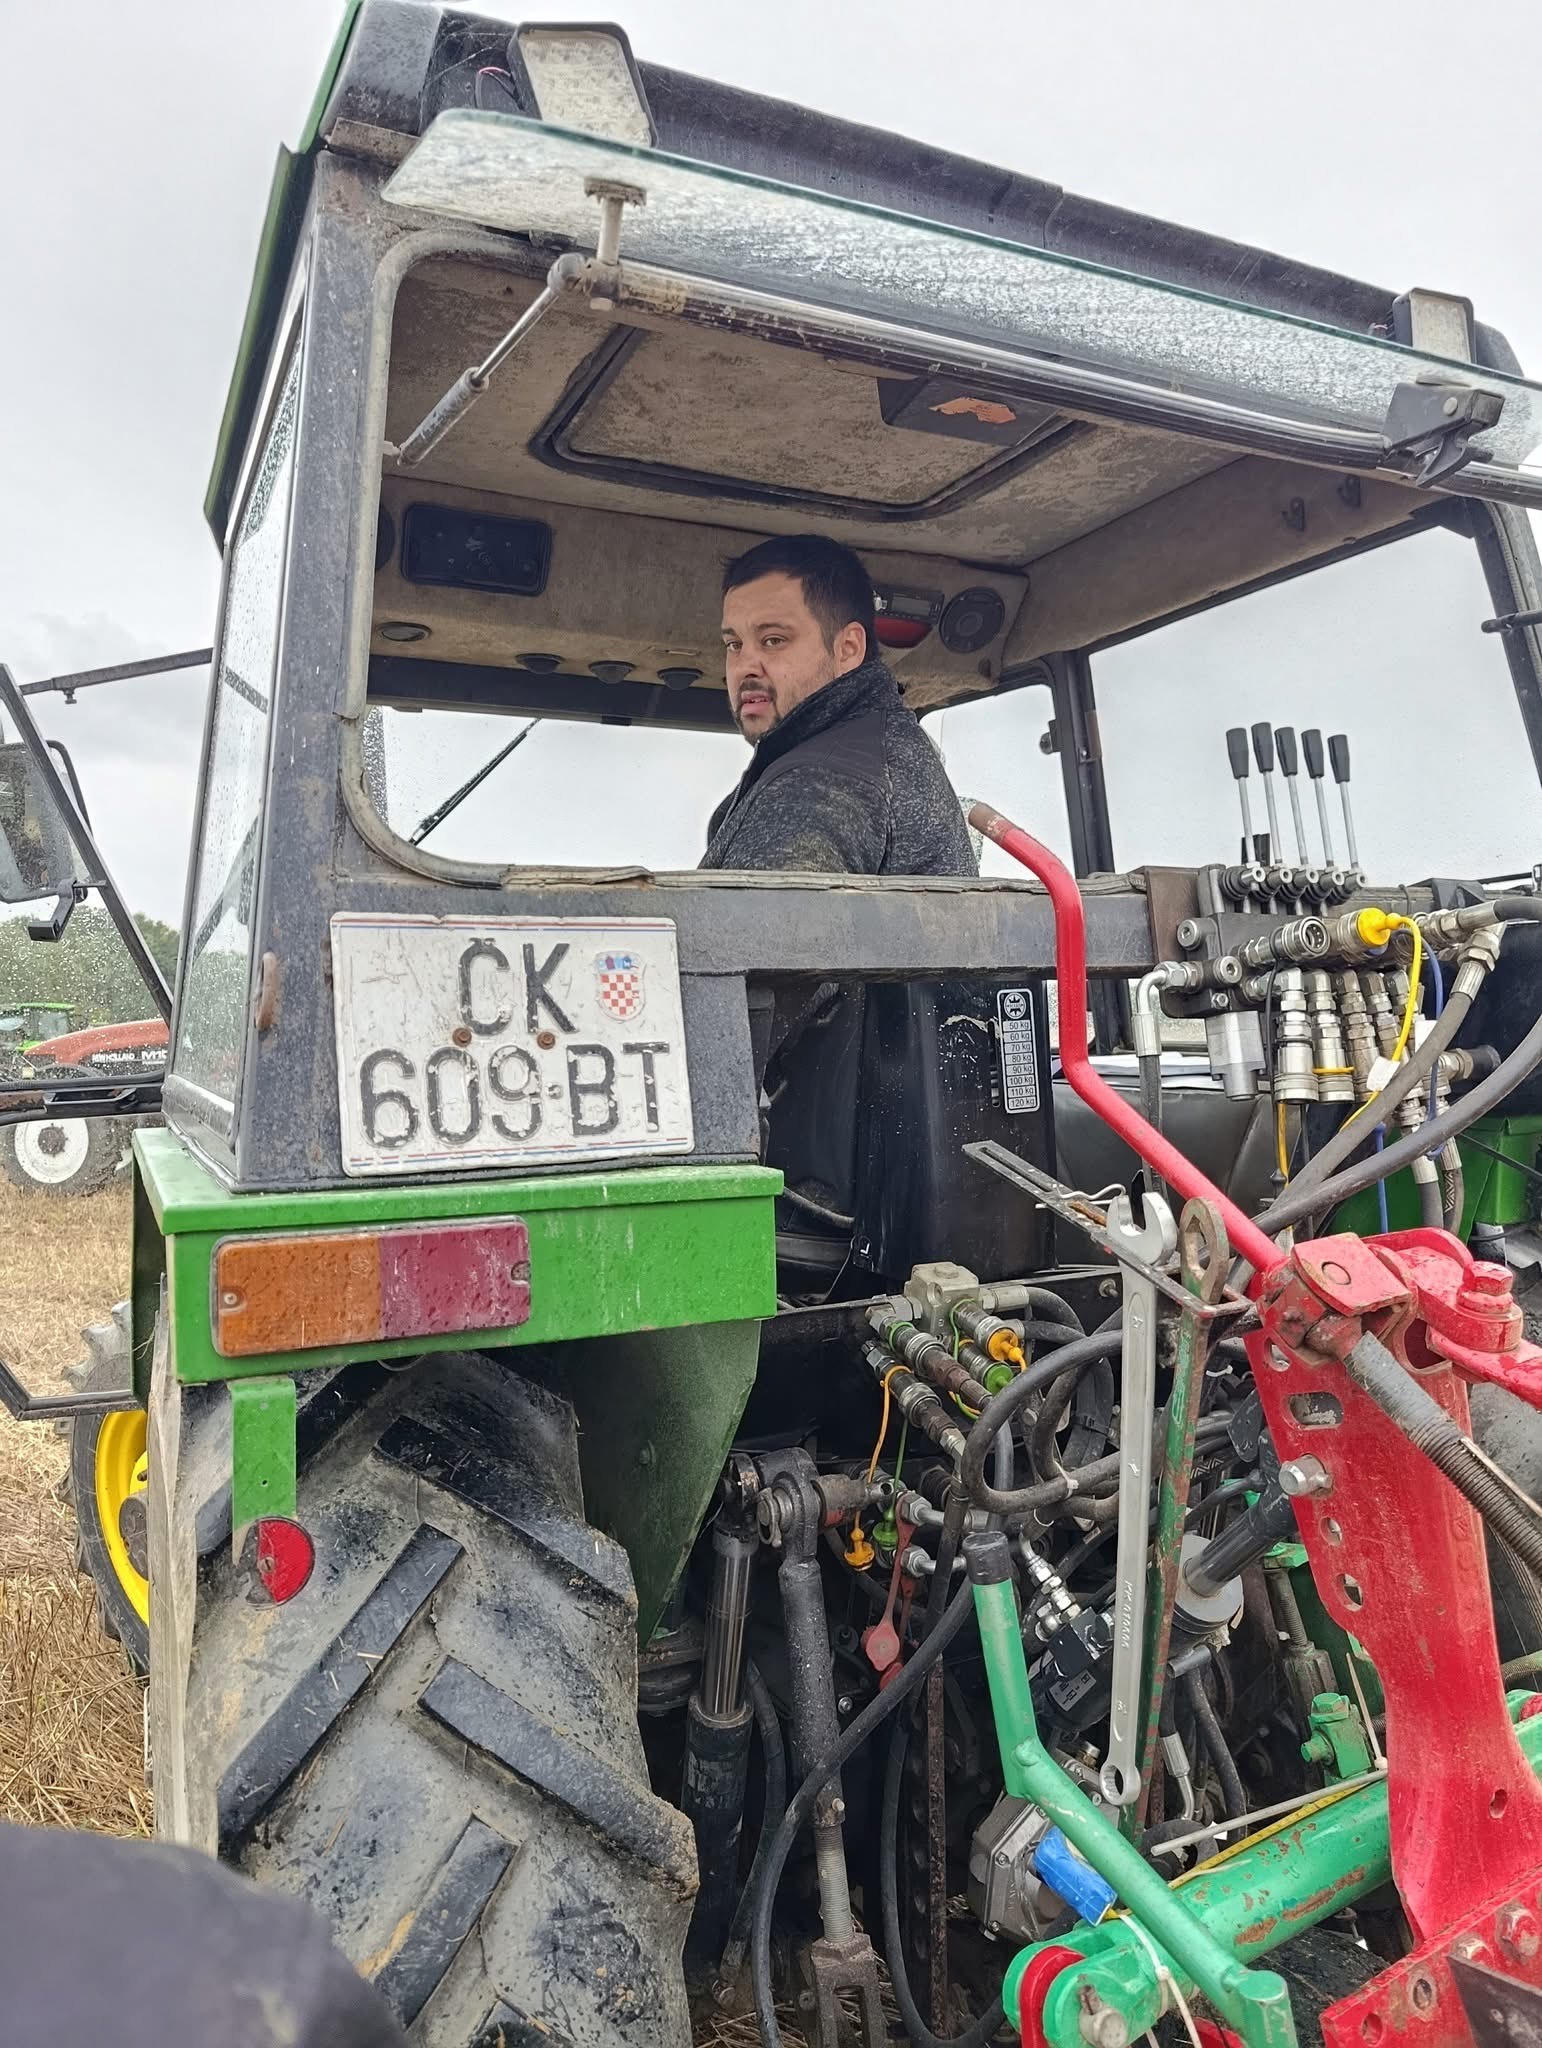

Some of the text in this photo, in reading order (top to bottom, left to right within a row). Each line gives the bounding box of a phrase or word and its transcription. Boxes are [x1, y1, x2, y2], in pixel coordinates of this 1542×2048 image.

[1009, 1021, 1030, 1030] 50 kg
[1010, 1032, 1030, 1041] 60 kg
[1011, 1043, 1031, 1052] 70 kg
[1011, 1054, 1032, 1063] 80 kg
[1012, 1065, 1033, 1074] 90 kg
[1010, 1076, 1033, 1085] 100 kg
[1011, 1087, 1034, 1096] 110 kg
[1011, 1098, 1035, 1107] 120 kg
